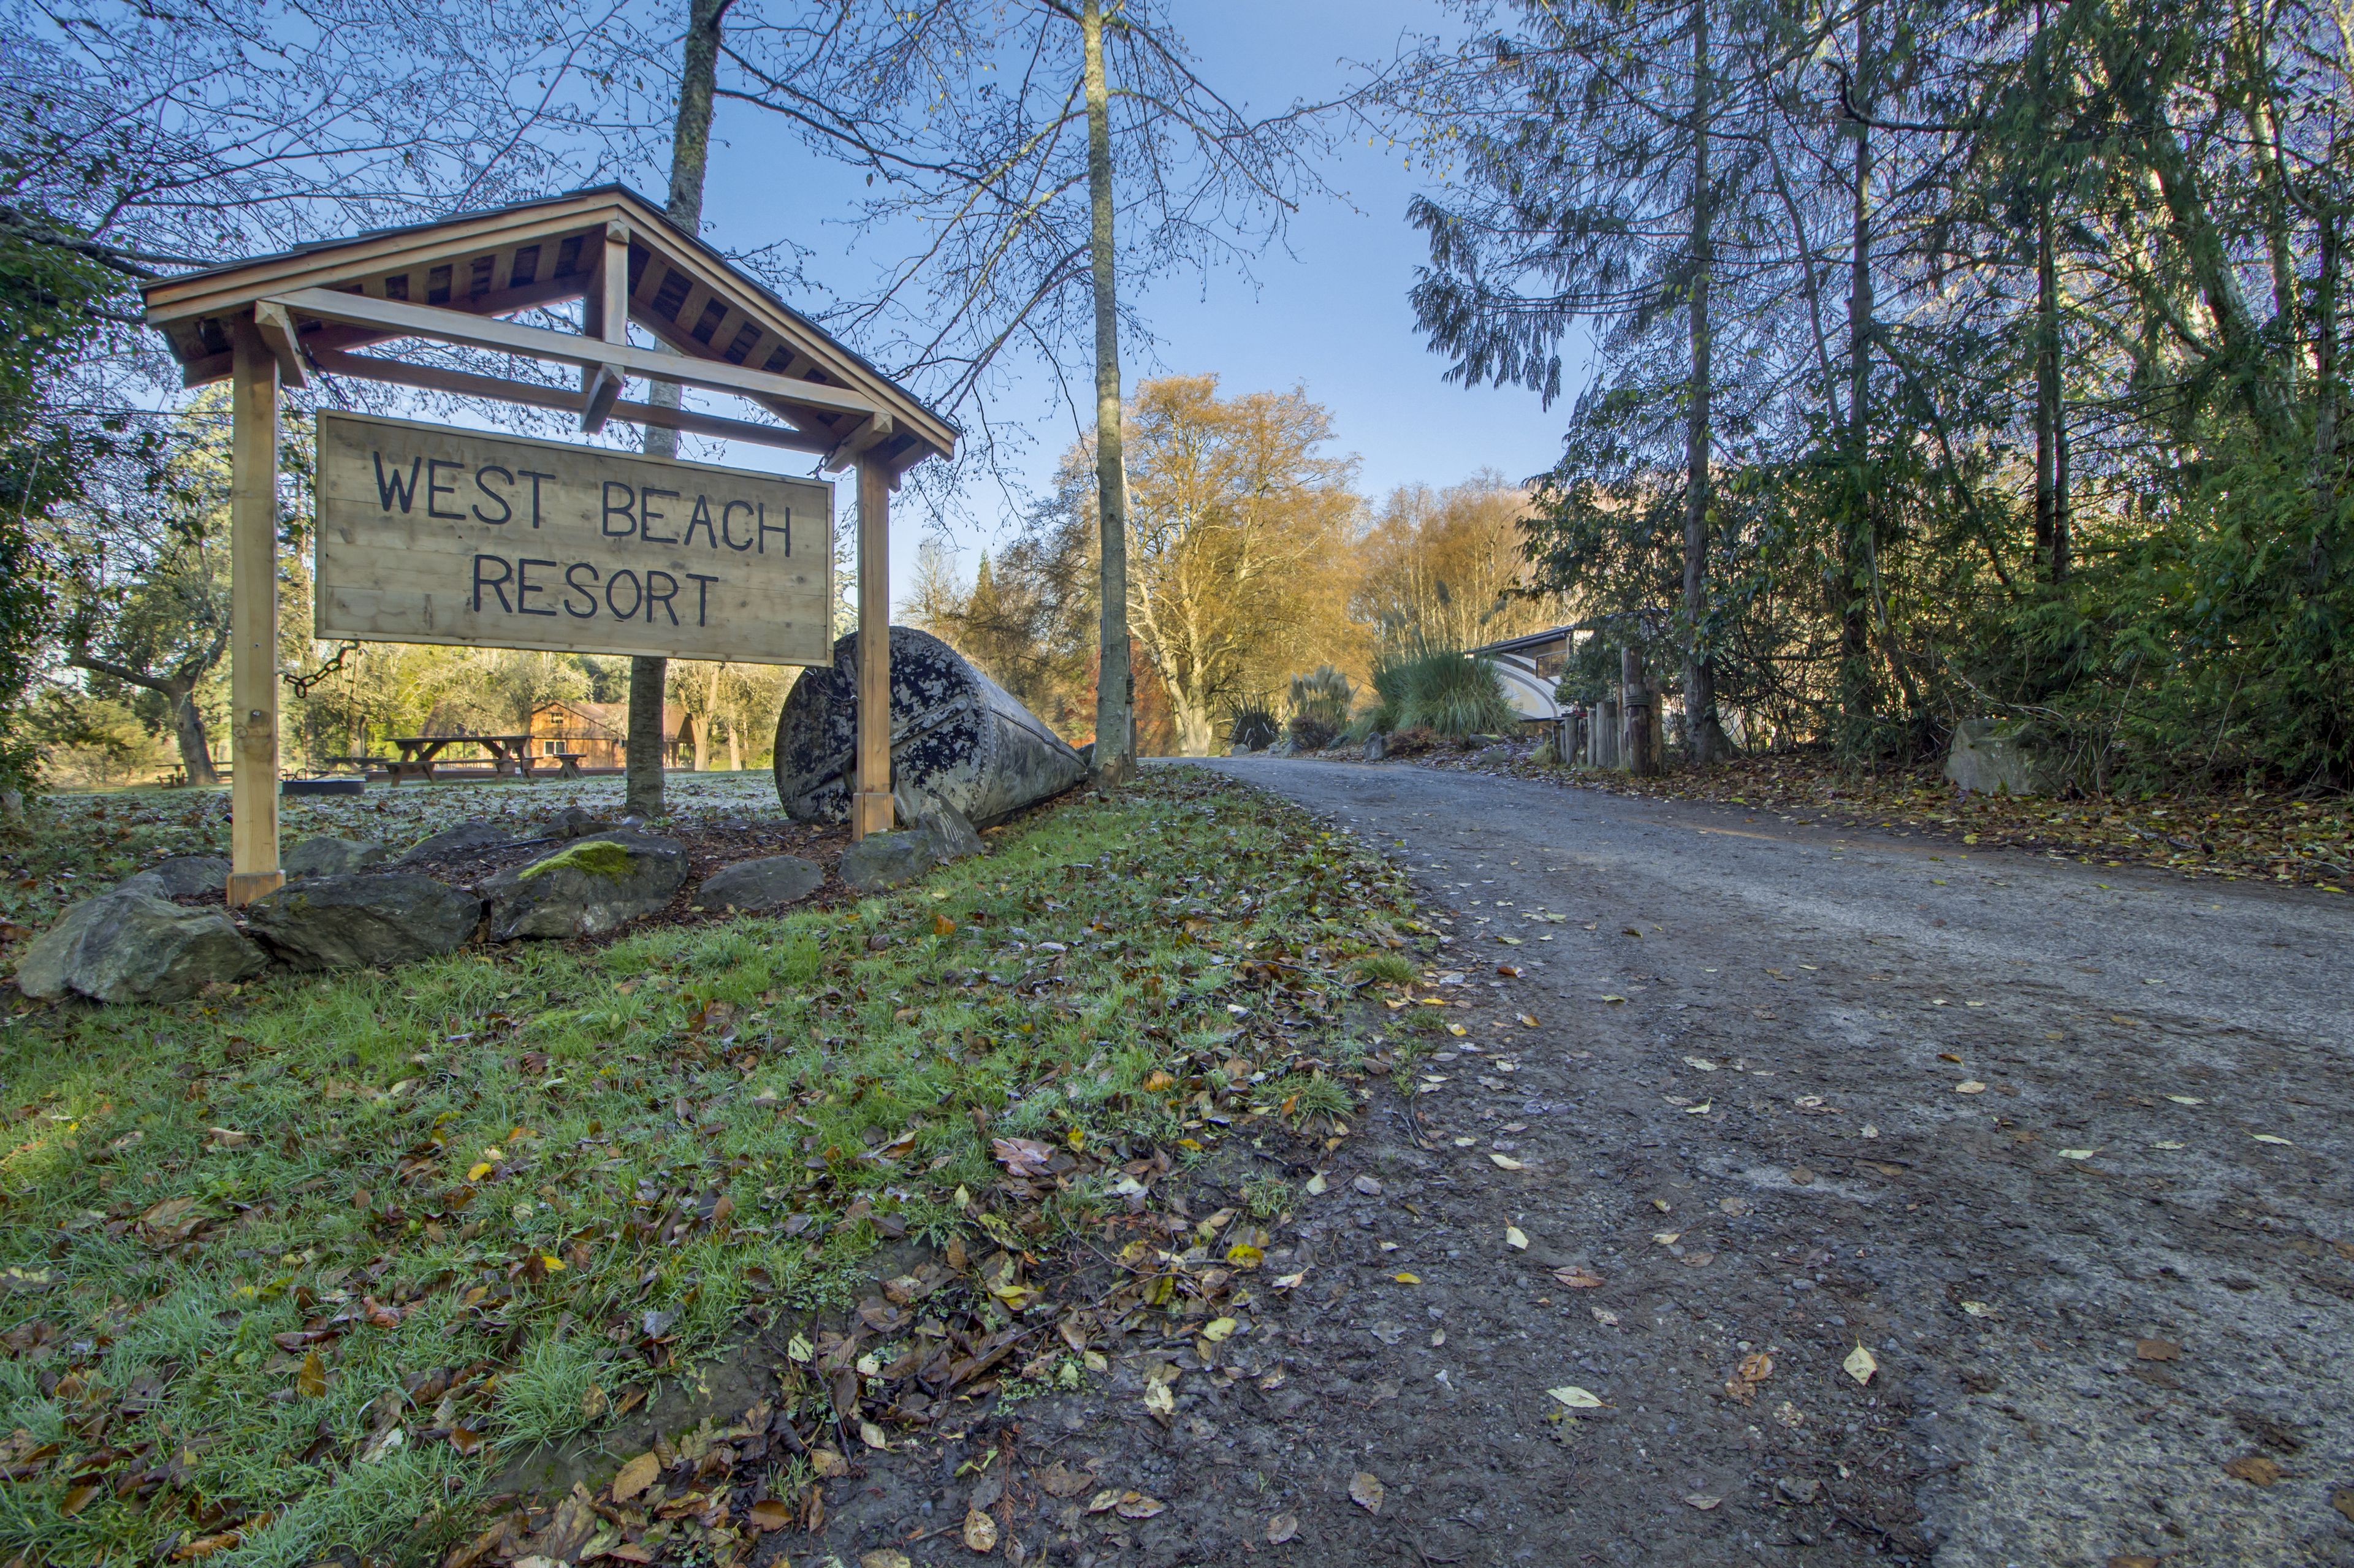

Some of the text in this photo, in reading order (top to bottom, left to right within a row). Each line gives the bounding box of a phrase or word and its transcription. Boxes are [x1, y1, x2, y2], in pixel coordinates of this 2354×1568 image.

[373, 451, 791, 557] WEST BEACH
[473, 554, 719, 627] RESORT
